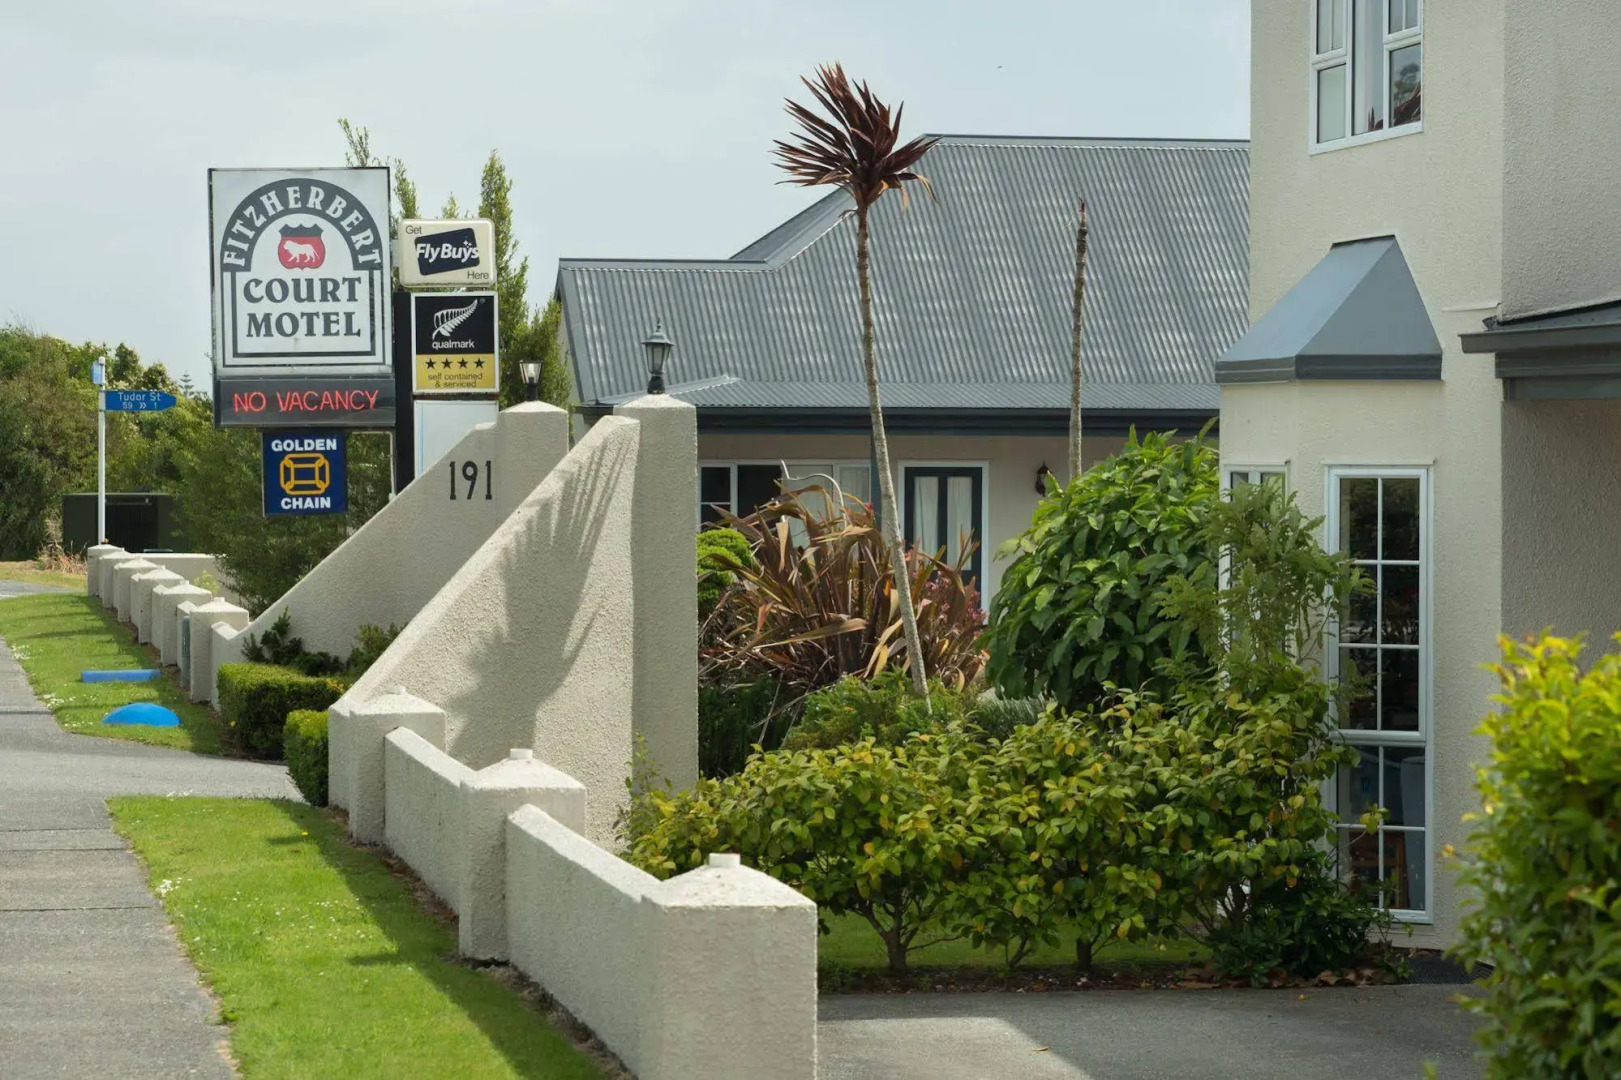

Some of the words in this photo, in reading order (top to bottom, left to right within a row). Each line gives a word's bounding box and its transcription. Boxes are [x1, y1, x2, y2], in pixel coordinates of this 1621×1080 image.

[223, 185, 381, 267] FITZHERBERT
[405, 225, 422, 235] Get
[467, 271, 489, 280] Here
[243, 276, 361, 303] COURT
[246, 311, 361, 338] MOTEL
[432, 339, 475, 350] qualmark
[428, 372, 442, 380] self
[444, 372, 483, 380] contained
[443, 380, 477, 388] serviced
[118, 392, 145, 401] Tudor
[149, 392, 161, 401] St
[233, 391, 267, 413] NO
[276, 389, 379, 412] VACANCY
[271, 438, 337, 452] GOLDEN
[449, 460, 493, 500] 191
[280, 496, 332, 510] CHAIN
